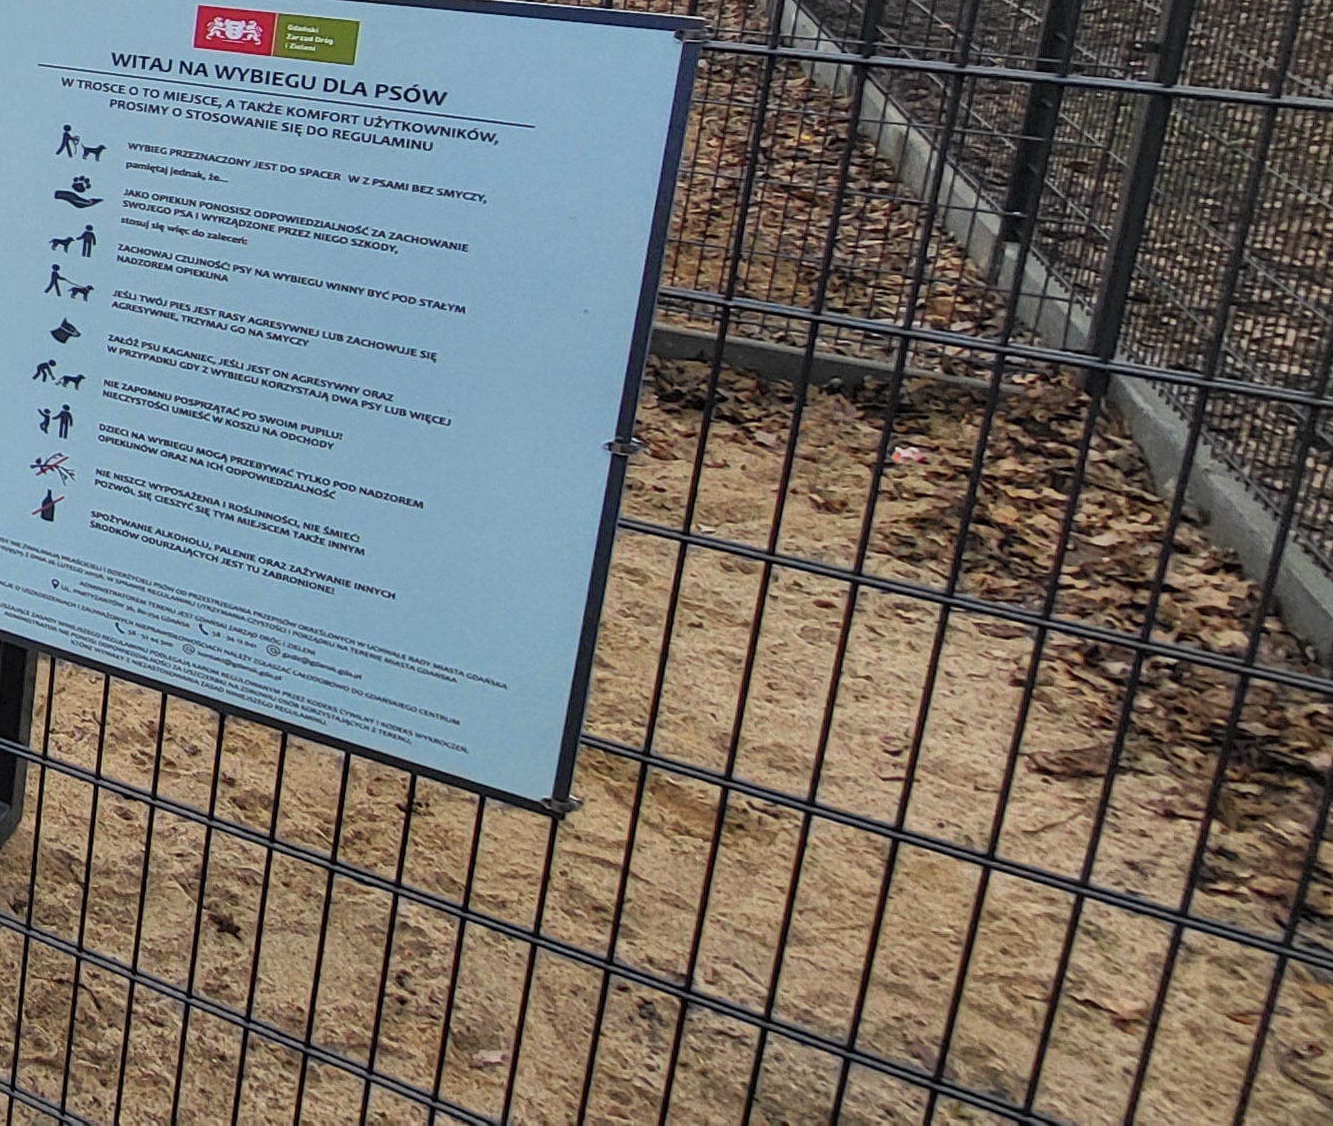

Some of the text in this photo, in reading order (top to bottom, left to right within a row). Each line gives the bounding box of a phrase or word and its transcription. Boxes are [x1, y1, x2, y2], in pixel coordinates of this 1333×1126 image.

[61, 76, 499, 145] W TROSCE O TO MIEJSCE, A TAKŻE KOMFORT UŻYTKOWNIKÓW,
[110, 51, 447, 107] WITAJ NA WYBIEGU DLA PSÓW
[109, 98, 434, 152] PROSIMY O STOSOWANIE SIĘ DO REGULAMINU
[127, 141, 487, 204] WYBIEG PRZEZNACZONY JEST DO SPACER W Z PSAMI BEZ SMYCZY,
[122, 199, 399, 254] SWOJEGO PSA I WYRZĄDZONE PRZEZ NIEGO SZKODY,
[123, 188, 469, 252] JAKO OPIEKUN PONOSISZ ODPOWIEDZIALNOŚĆ ZA ZACHOWANIE
[190, 227, 205, 238] do
[116, 254, 229, 282] NADZOREM OPIEKUNA
[117, 243, 173, 260] ZACHOWAJ
[232, 264, 252, 275] PSY
[254, 267, 270, 278] NA
[272, 271, 323, 288] WYBIEGU
[325, 280, 365, 295] WINNY
[366, 288, 389, 300] BYĆ
[391, 292, 417, 305] POD
[418, 297, 466, 314] STAŁYM
[112, 289, 437, 362] JEŚLI TWÓJ PIES JEST RASY AGRESYWNEJ LUB ZACHOWUJE SIĘ
[181, 314, 228, 331] TRZYMAJ
[229, 324, 246, 334] GO
[247, 327, 264, 338] NA
[265, 331, 309, 347] SMYCZY
[106, 344, 451, 427] W PRZYPADKU GDY Z WYBIEGU KORZYSTAJĄ DWA PSY LUB WIĘCEJ
[107, 333, 139, 347] ZAŁÓŻ
[140, 340, 161, 352] PSU
[218, 357, 244, 370] JEŚLI
[246, 363, 271, 375] JEST
[271, 368, 289, 379] ON
[290, 372, 360, 395] AGRESYWNY
[361, 387, 394, 402] ORAZ
[102, 389, 334, 450] NIECZYSTOŚCI UMIEŚĆ W KOSZU NA ODCHODY
[103, 378, 120, 389] NIE
[173, 394, 240, 417] POSPRZĄTAĆ
[241, 409, 257, 421] PO
[258, 413, 298, 430] SWOIM
[97, 433, 336, 500] OPIEKUNÓW ORAZ NA ICH ODPOWIEDZIALNOŚĆ
[98, 422, 424, 509] DZIECI NA WYBIEGU MOGĄ PRZEBYWAĆ TYLKO POD NADZOREM
[94, 478, 365, 556] POZWÓL SIĘ CIESZYĆ SIĘ TYM MIEJSCEM TAKŻE INNYM
[95, 467, 111, 478] NIE
[112, 472, 146, 488] NISZCZ
[147, 481, 221, 507] WYPOSAŻENIA
[221, 500, 226, 508] I
[227, 501, 300, 529] ROŚLINNOŚCI,
[302, 521, 320, 533] NIE
[89, 519, 335, 595] ŚRODKÓW ODURZAJĄCYCH JEST TU ZABRONIONE!
[90, 509, 396, 600] SPOŻYWANIE ALKOHOLU, PALENIE ORAZ ZAŻYWANIE INNYCH
